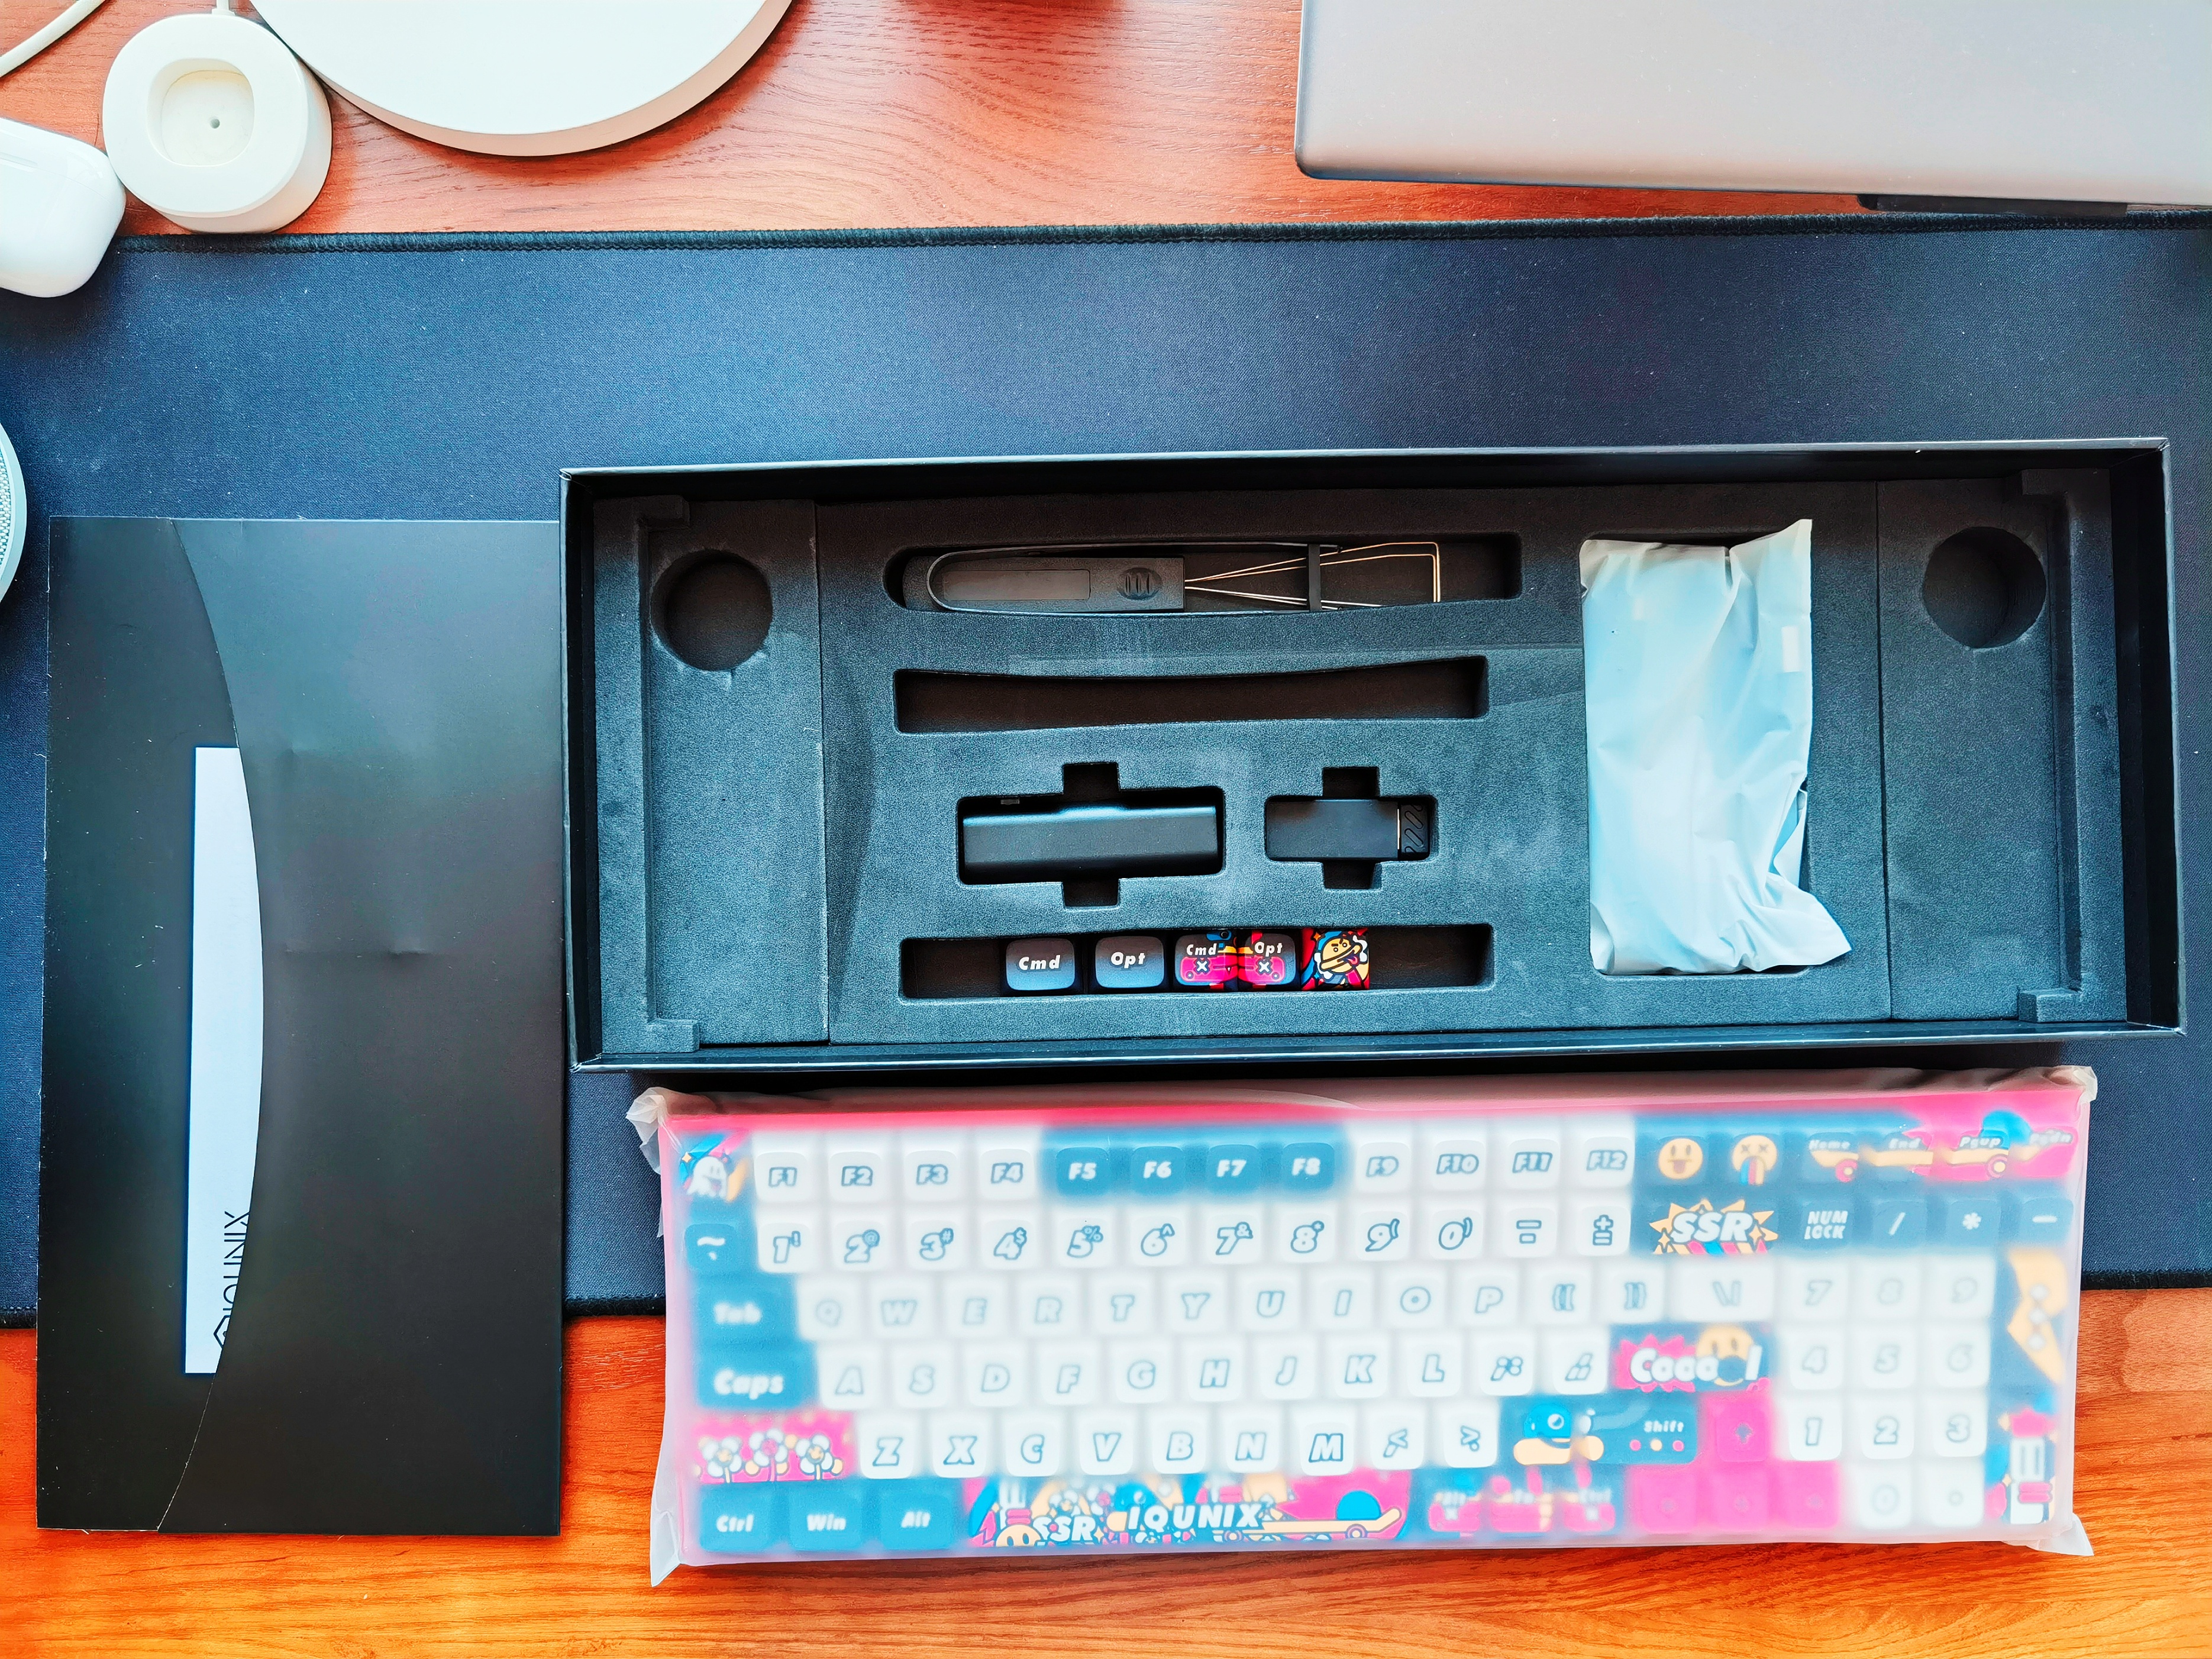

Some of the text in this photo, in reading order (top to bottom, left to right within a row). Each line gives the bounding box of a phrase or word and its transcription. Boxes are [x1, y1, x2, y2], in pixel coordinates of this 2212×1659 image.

[1019, 954, 1060, 971] Cmd
[1110, 951, 1145, 969] Opt
[1186, 943, 1218, 957] Cmd
[1254, 942, 1283, 956] Opt
[1809, 1140, 1850, 1150] Home
[1889, 1137, 1921, 1149] End
[916, 1163, 948, 1184] F3
[991, 1162, 1023, 1183] F4
[1068, 1161, 1097, 1180] F5
[1143, 1160, 1172, 1179] F6
[1216, 1159, 1247, 1177] F7
[1291, 1157, 1321, 1176] F8
[1366, 1156, 1399, 1177] F9
[1436, 1153, 1479, 1174] F10
[1512, 1151, 1553, 1173] F11
[1586, 1150, 1627, 1171] F12
[768, 1166, 797, 1187] F1
[841, 1166, 873, 1186] F2
[1670, 1211, 1754, 1243] SSR
[1808, 1211, 1848, 1225] NUM
[1804, 1225, 1846, 1240] LOCK
[1181, 1292, 1210, 1320] Y
[1256, 1290, 1285, 1318] U
[1334, 1289, 1352, 1316] I
[1400, 1286, 1431, 1314] O
[1474, 1286, 1503, 1313] P
[1806, 1279, 1833, 1306] 7
[815, 1299, 842, 1326] Q
[880, 1299, 917, 1326] W
[963, 1298, 988, 1325] E
[1034, 1297, 1062, 1324] R
[1110, 1294, 1135, 1322] T
[835, 1365, 863, 1395] A
[909, 1365, 935, 1394] S
[981, 1364, 1010, 1392] D
[1057, 1364, 1080, 1394] F
[1127, 1360, 1156, 1390] G
[1200, 1358, 1230, 1388] H
[1275, 1355, 1297, 1386] J
[1344, 1354, 1375, 1384] K
[1422, 1354, 1445, 1383] L
[714, 1368, 784, 1399] Caps
[1643, 1421, 1684, 1432] Shift
[1805, 1416, 1822, 1446] 1
[1874, 1415, 1900, 1445] 2
[1946, 1413, 1971, 1443] 3
[873, 1437, 903, 1466] Z
[943, 1435, 976, 1464] X
[1021, 1434, 1045, 1464] C
[1093, 1432, 1122, 1462] V
[1166, 1431, 1194, 1461] B
[1235, 1431, 1267, 1461] N
[1308, 1432, 1344, 1463] M
[716, 1515, 754, 1533] Ctrl
[806, 1514, 847, 1531] Win
[1032, 1503, 1262, 1542] SSR IQUNIX
